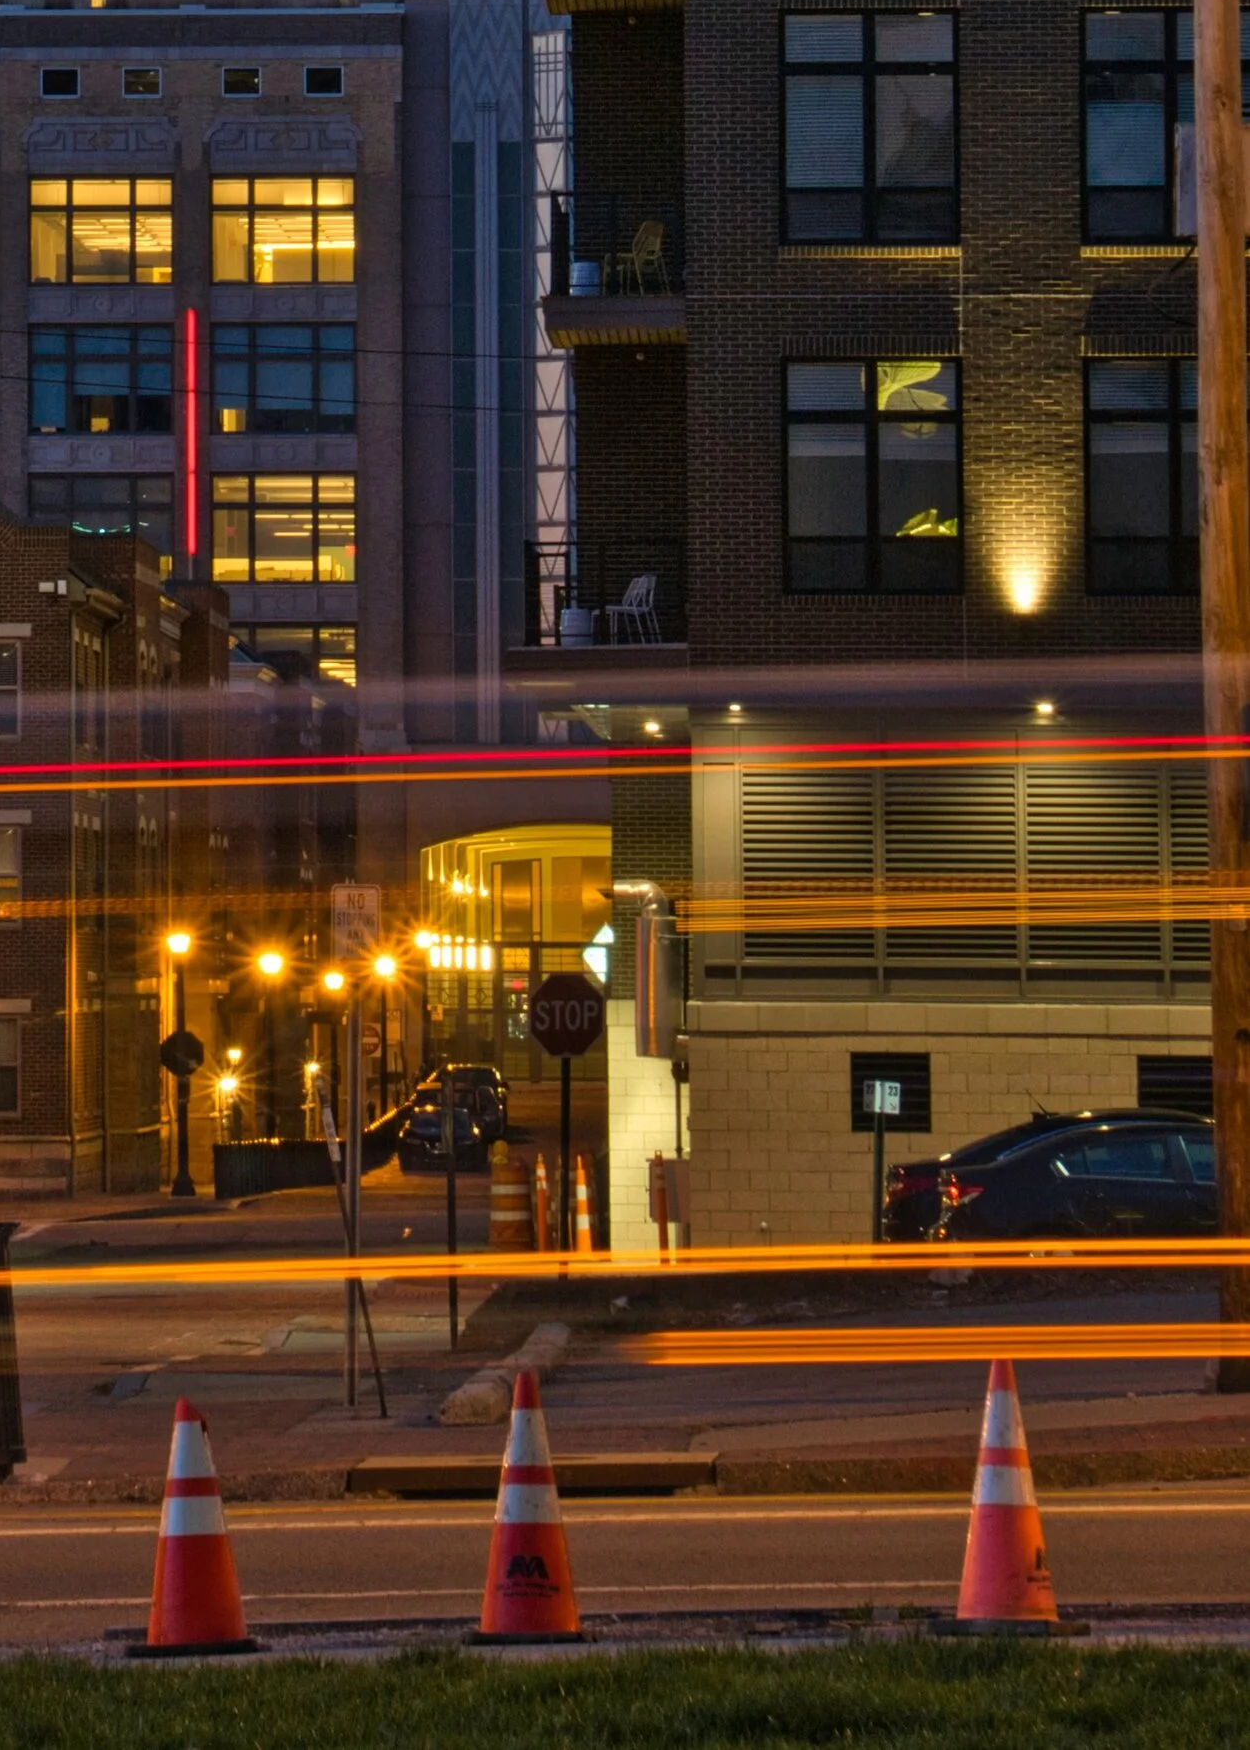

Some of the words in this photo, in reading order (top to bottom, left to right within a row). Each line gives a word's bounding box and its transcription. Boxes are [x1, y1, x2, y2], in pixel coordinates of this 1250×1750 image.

[347, 893, 366, 910] NO
[535, 999, 600, 1031] STOP
[888, 1085, 899, 1097] 23
